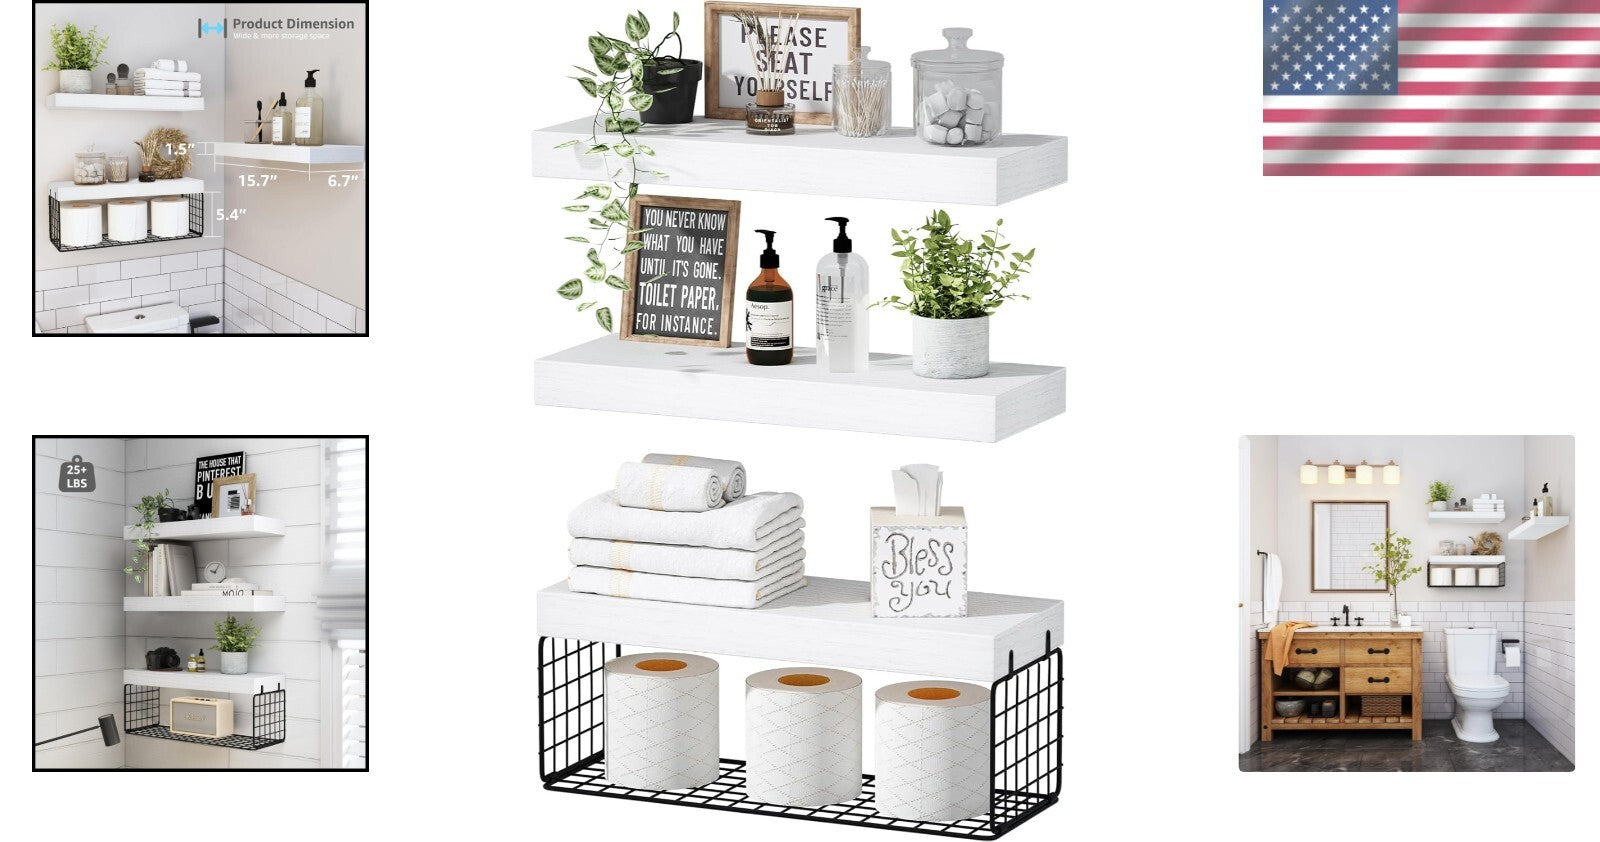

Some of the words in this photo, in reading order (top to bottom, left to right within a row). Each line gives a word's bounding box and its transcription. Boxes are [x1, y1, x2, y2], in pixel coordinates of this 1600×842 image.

[741, 24, 827, 48] PEASE
[756, 50, 813, 75] SEAT
[734, 75, 833, 102] YOSELF
[645, 208, 664, 227] YOU
[665, 210, 696, 229] NEVER
[698, 212, 727, 231] KNOW
[643, 233, 670, 252] WHAT
[676, 235, 695, 253] YOU
[700, 237, 725, 256] HAVE
[640, 257, 667, 276] UNTIL
[672, 260, 689, 278] IT'S
[693, 261, 722, 280] GONE.
[639, 281, 678, 308] TOILET
[681, 284, 720, 311] PAPER,
[635, 312, 657, 330] FOR
[661, 314, 718, 336] INSTANCE.
[197, 466, 241, 483] PINTEREST
[198, 460, 209, 470] THE
[209, 457, 227, 469] HOUSE
[228, 455, 242, 466] THAT
[882, 532, 954, 580] Bless
